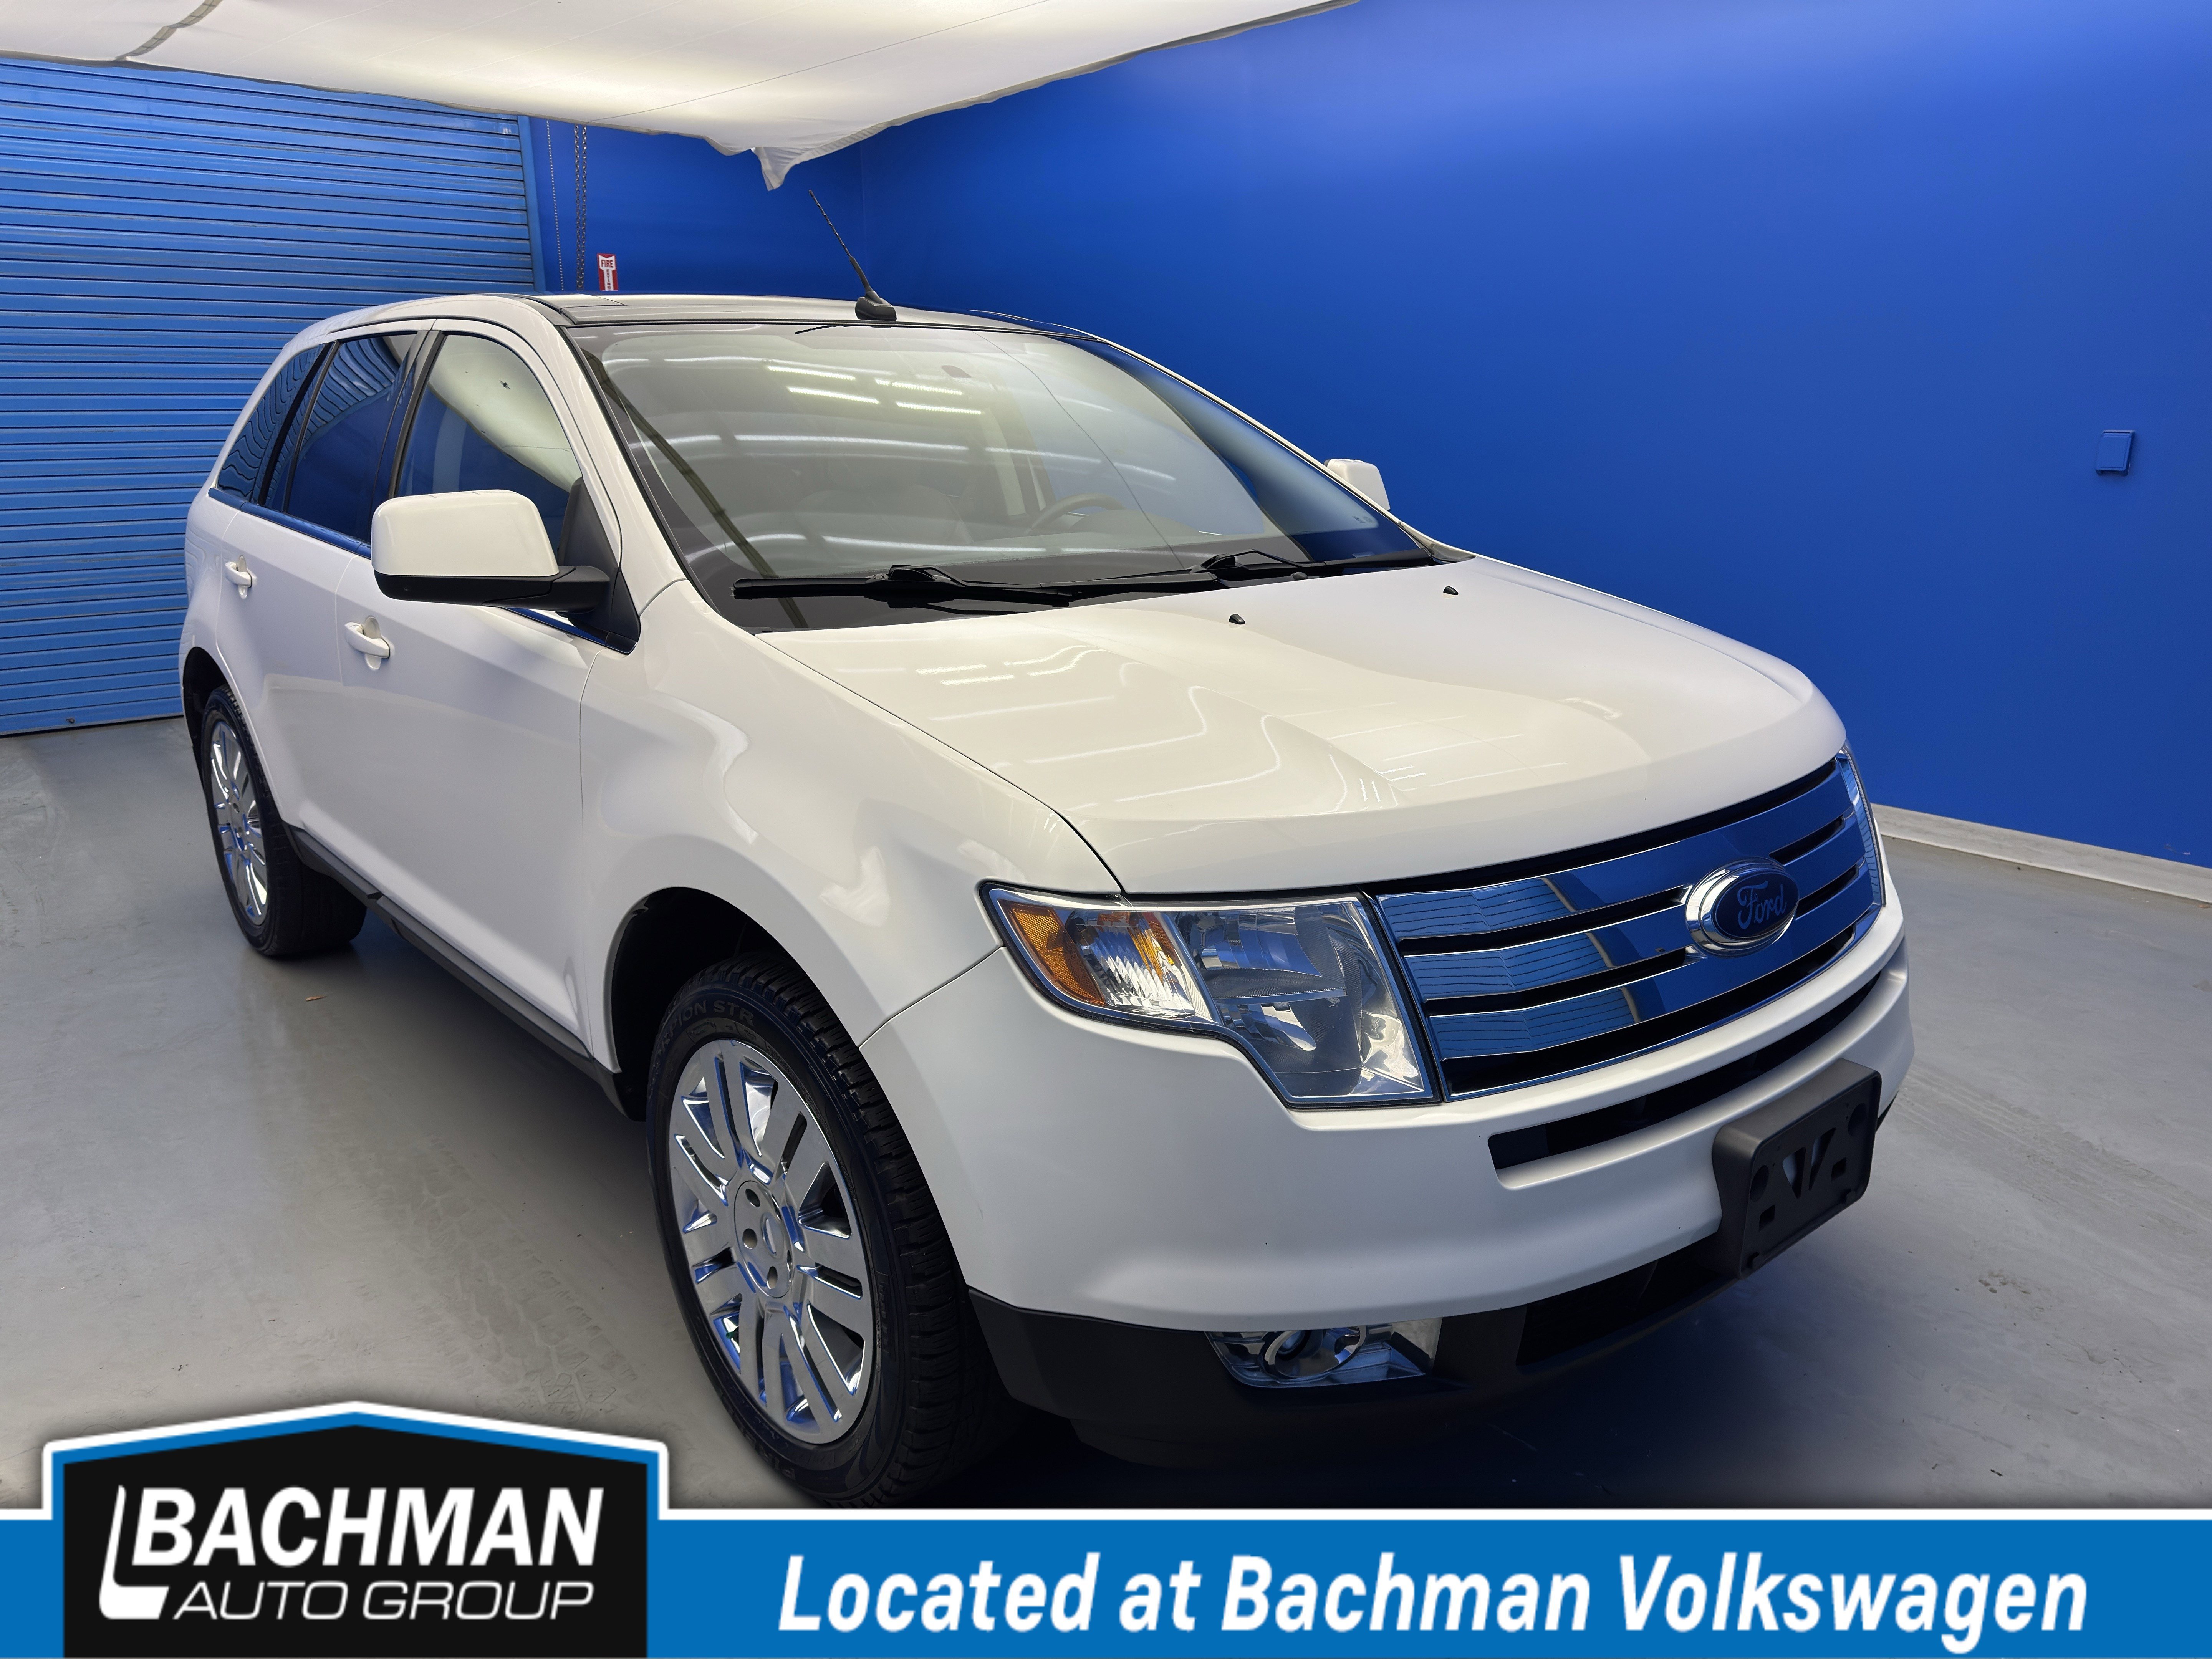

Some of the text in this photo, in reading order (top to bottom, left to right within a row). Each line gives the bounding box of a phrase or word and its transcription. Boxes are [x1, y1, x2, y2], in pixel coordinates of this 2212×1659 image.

[601, 259, 613, 268] FIRE
[1737, 881, 1785, 929] Ford
[713, 1000, 755, 1027] STR
